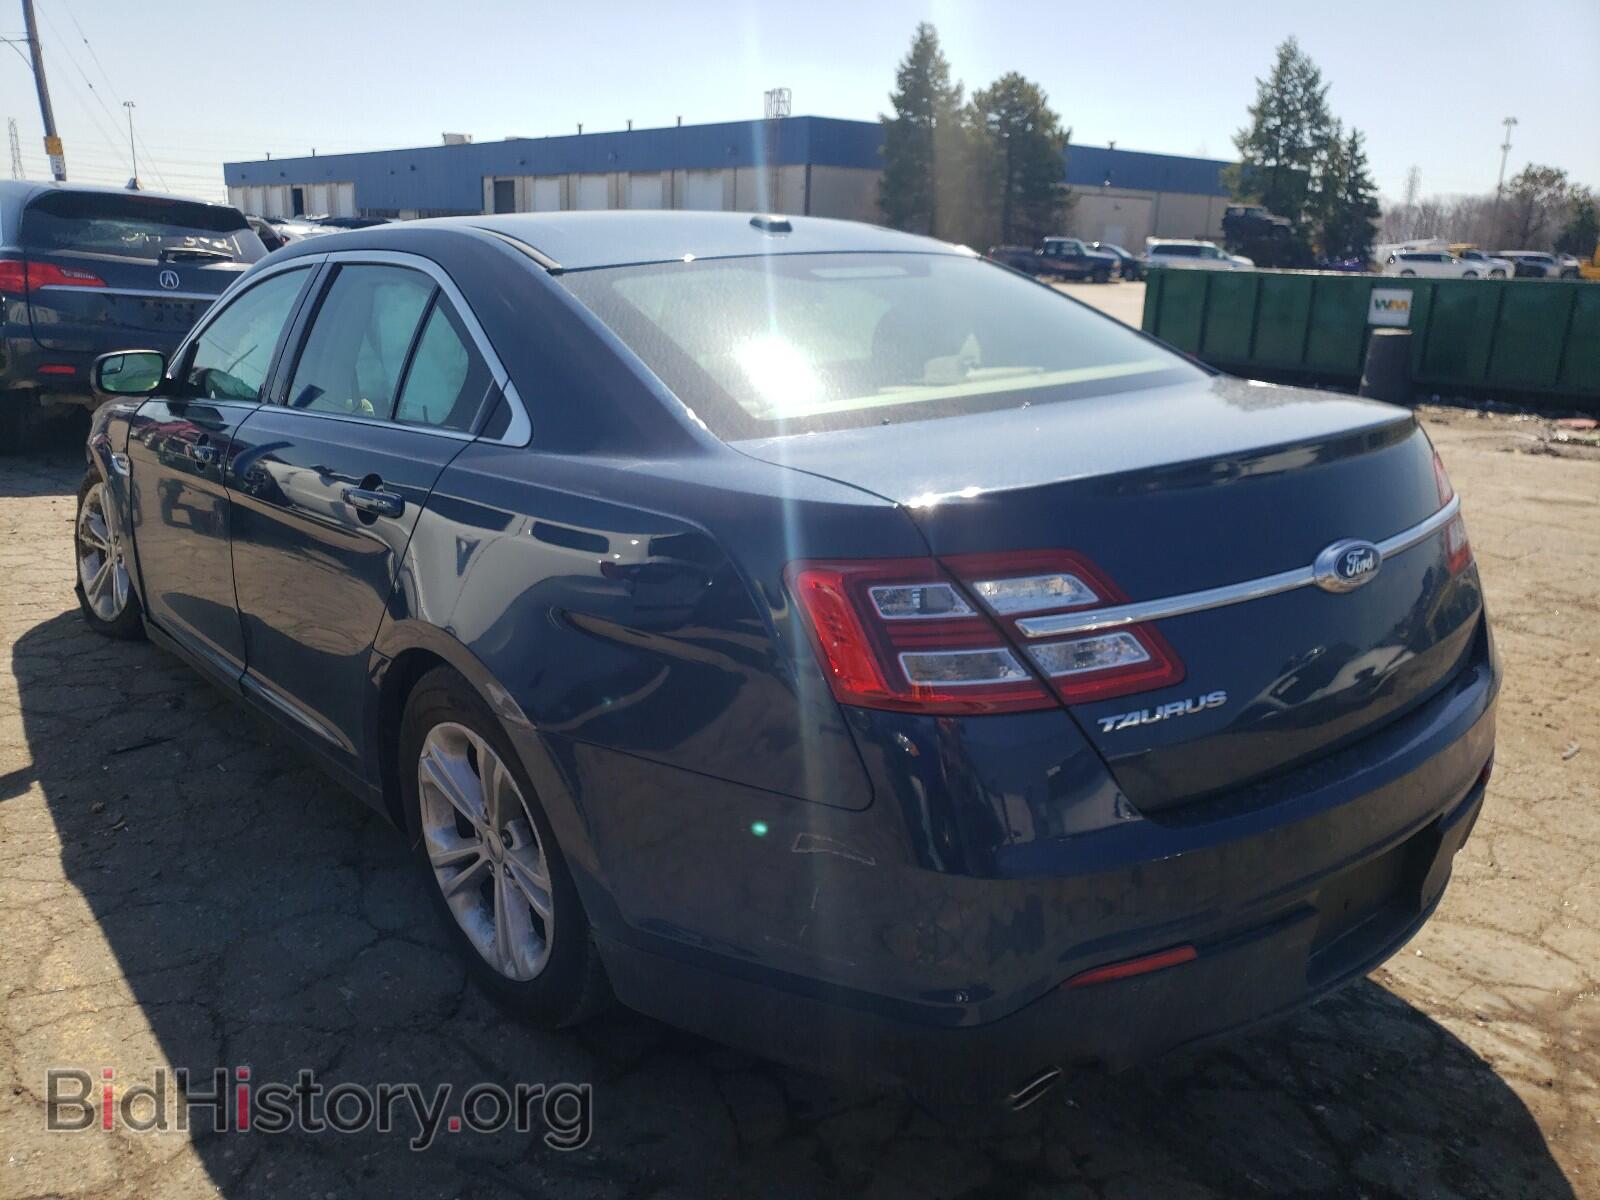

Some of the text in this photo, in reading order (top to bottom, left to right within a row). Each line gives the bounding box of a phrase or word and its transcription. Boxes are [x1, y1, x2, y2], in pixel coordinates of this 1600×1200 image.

[1374, 299, 1409, 311] WM
[1345, 549, 1374, 577] Ford
[1097, 690, 1228, 733] TAURUS
